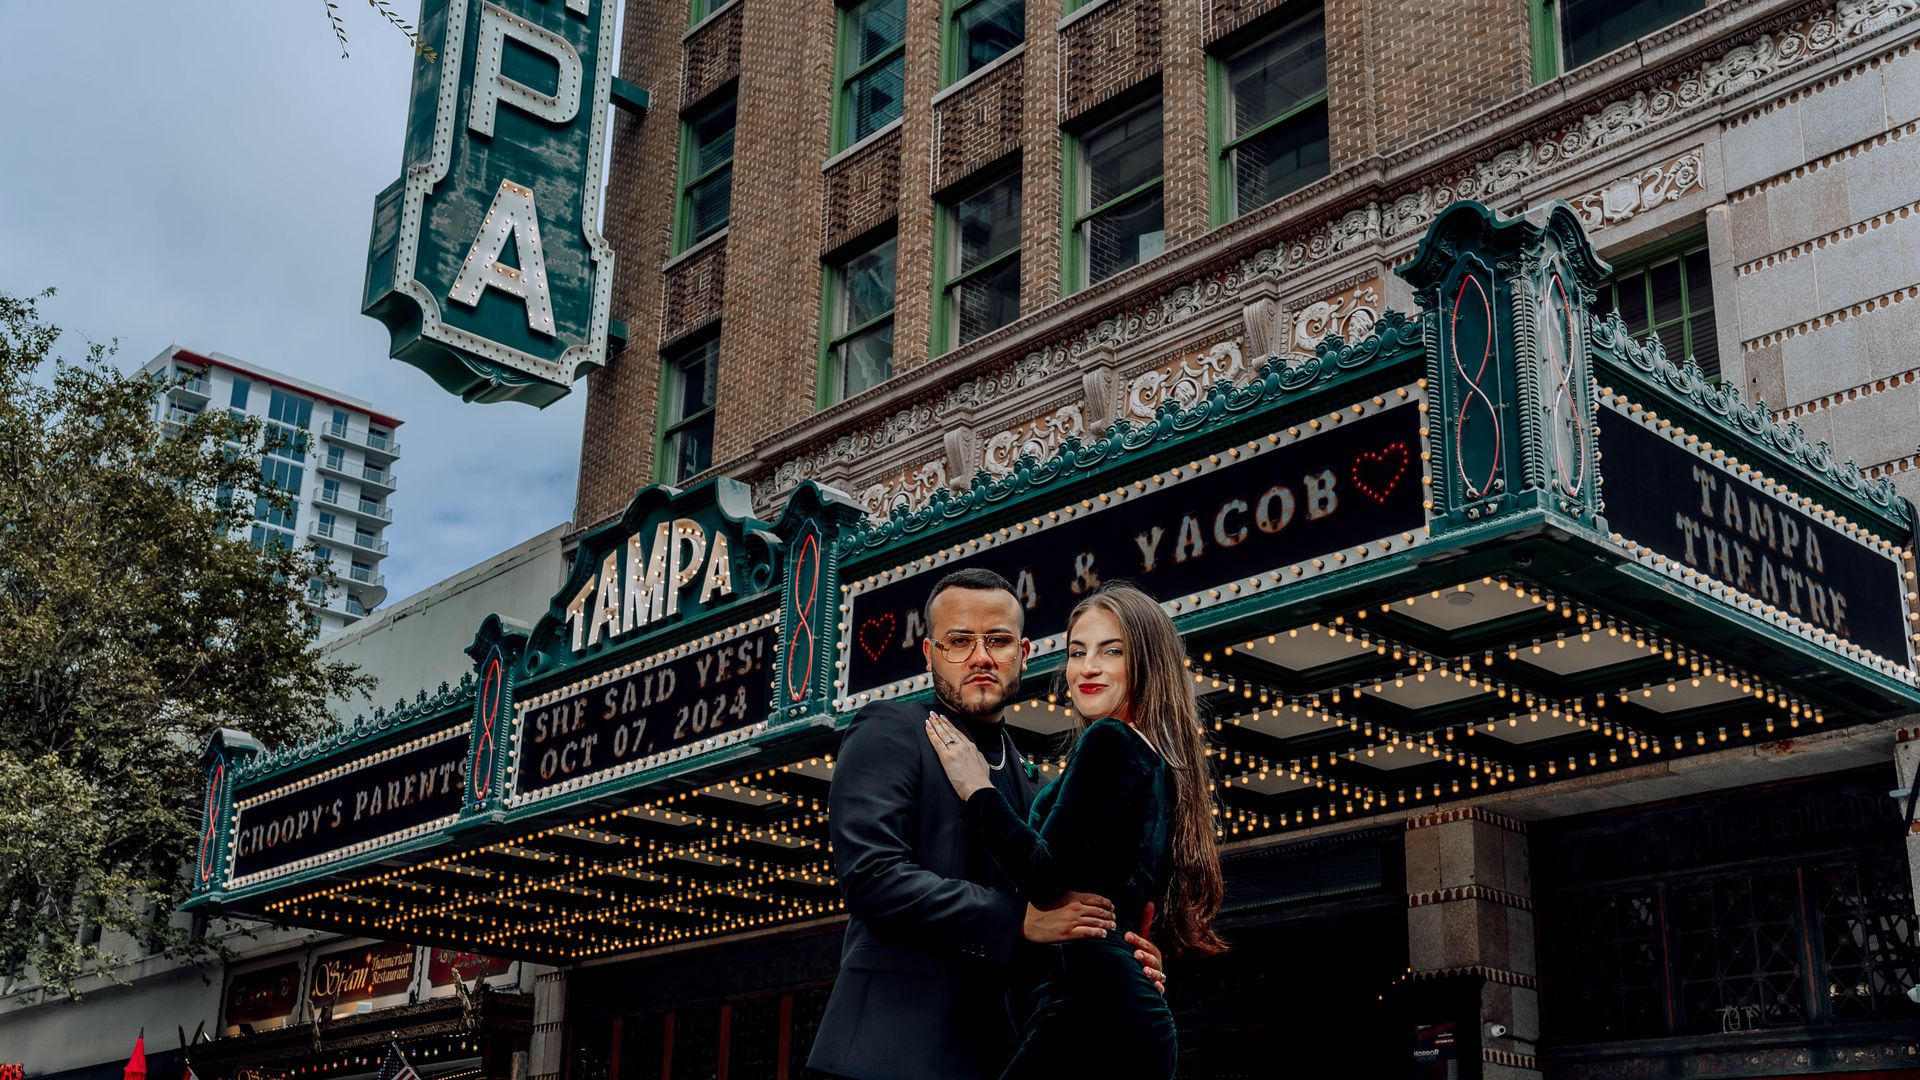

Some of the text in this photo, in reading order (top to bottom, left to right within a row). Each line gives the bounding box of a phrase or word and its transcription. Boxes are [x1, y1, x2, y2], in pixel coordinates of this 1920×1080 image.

[1071, 552, 1100, 594] &
[1134, 468, 1338, 573] YACOB
[1693, 464, 1824, 573] TAMPA
[565, 518, 734, 653] TAMPA
[1676, 511, 1850, 637] THEATRE
[534, 637, 764, 743] SHE SAID YES!
[540, 686, 747, 779] OCT 07, 2024
[238, 799, 343, 857] CHOOPY'S
[372, 965, 409, 984] Restaurant
